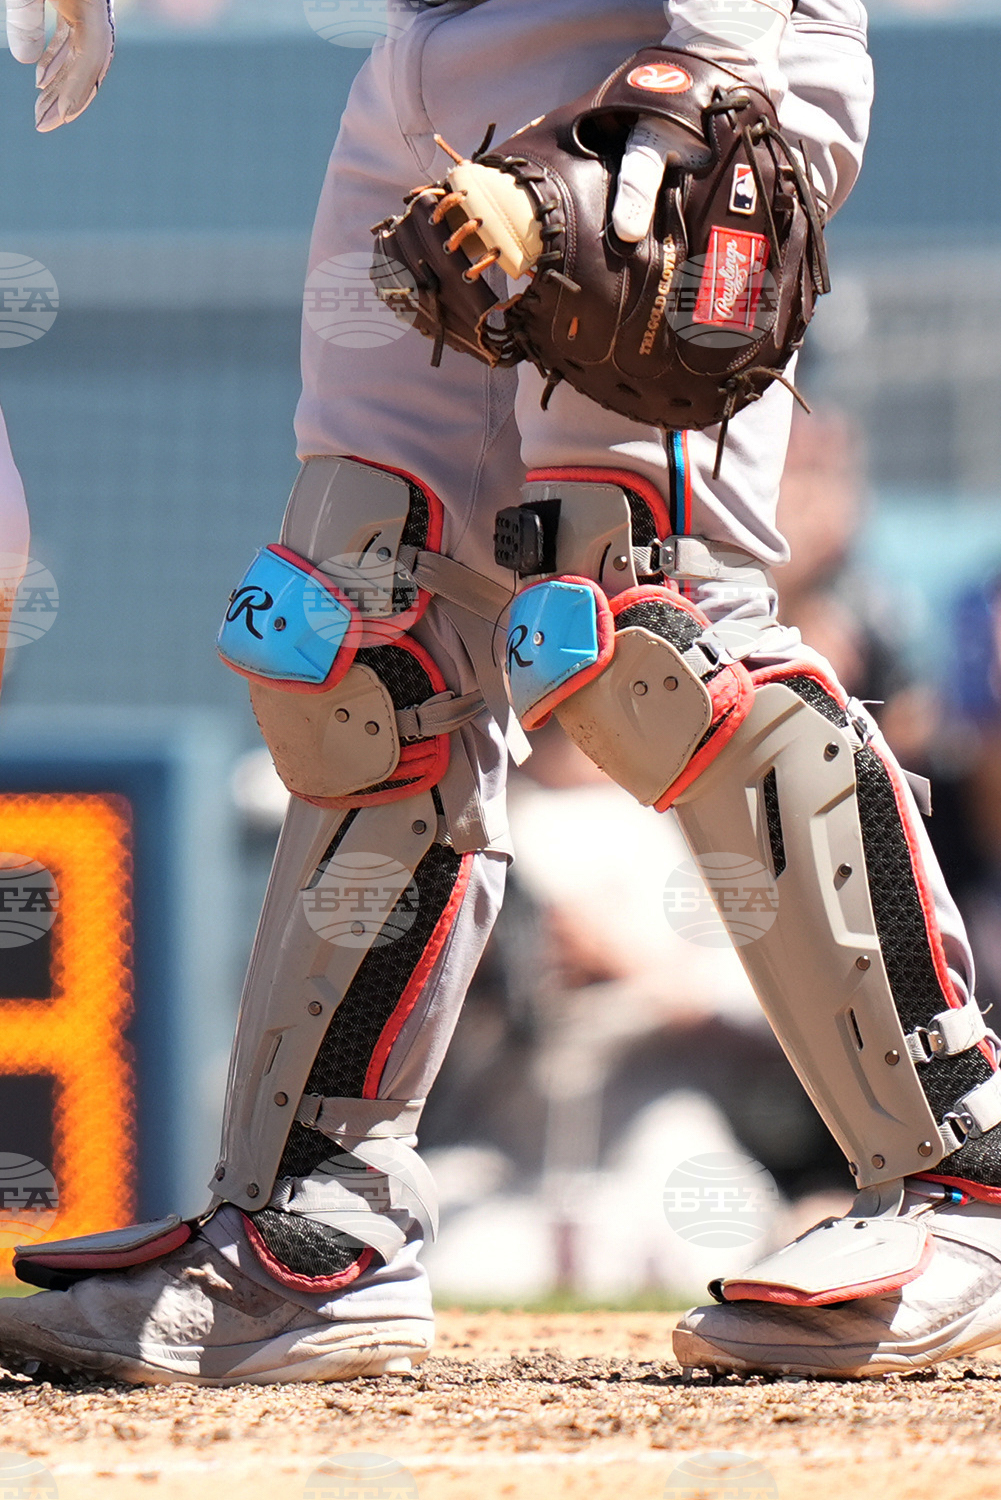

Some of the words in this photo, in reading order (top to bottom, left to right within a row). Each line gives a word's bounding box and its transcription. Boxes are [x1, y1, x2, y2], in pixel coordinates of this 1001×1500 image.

[647, 295, 667, 331] GOLD
[658, 252, 676, 296] GLOVE
[714, 239, 747, 319] Rawlings
[226, 585, 274, 640] R
[506, 624, 533, 677] R
